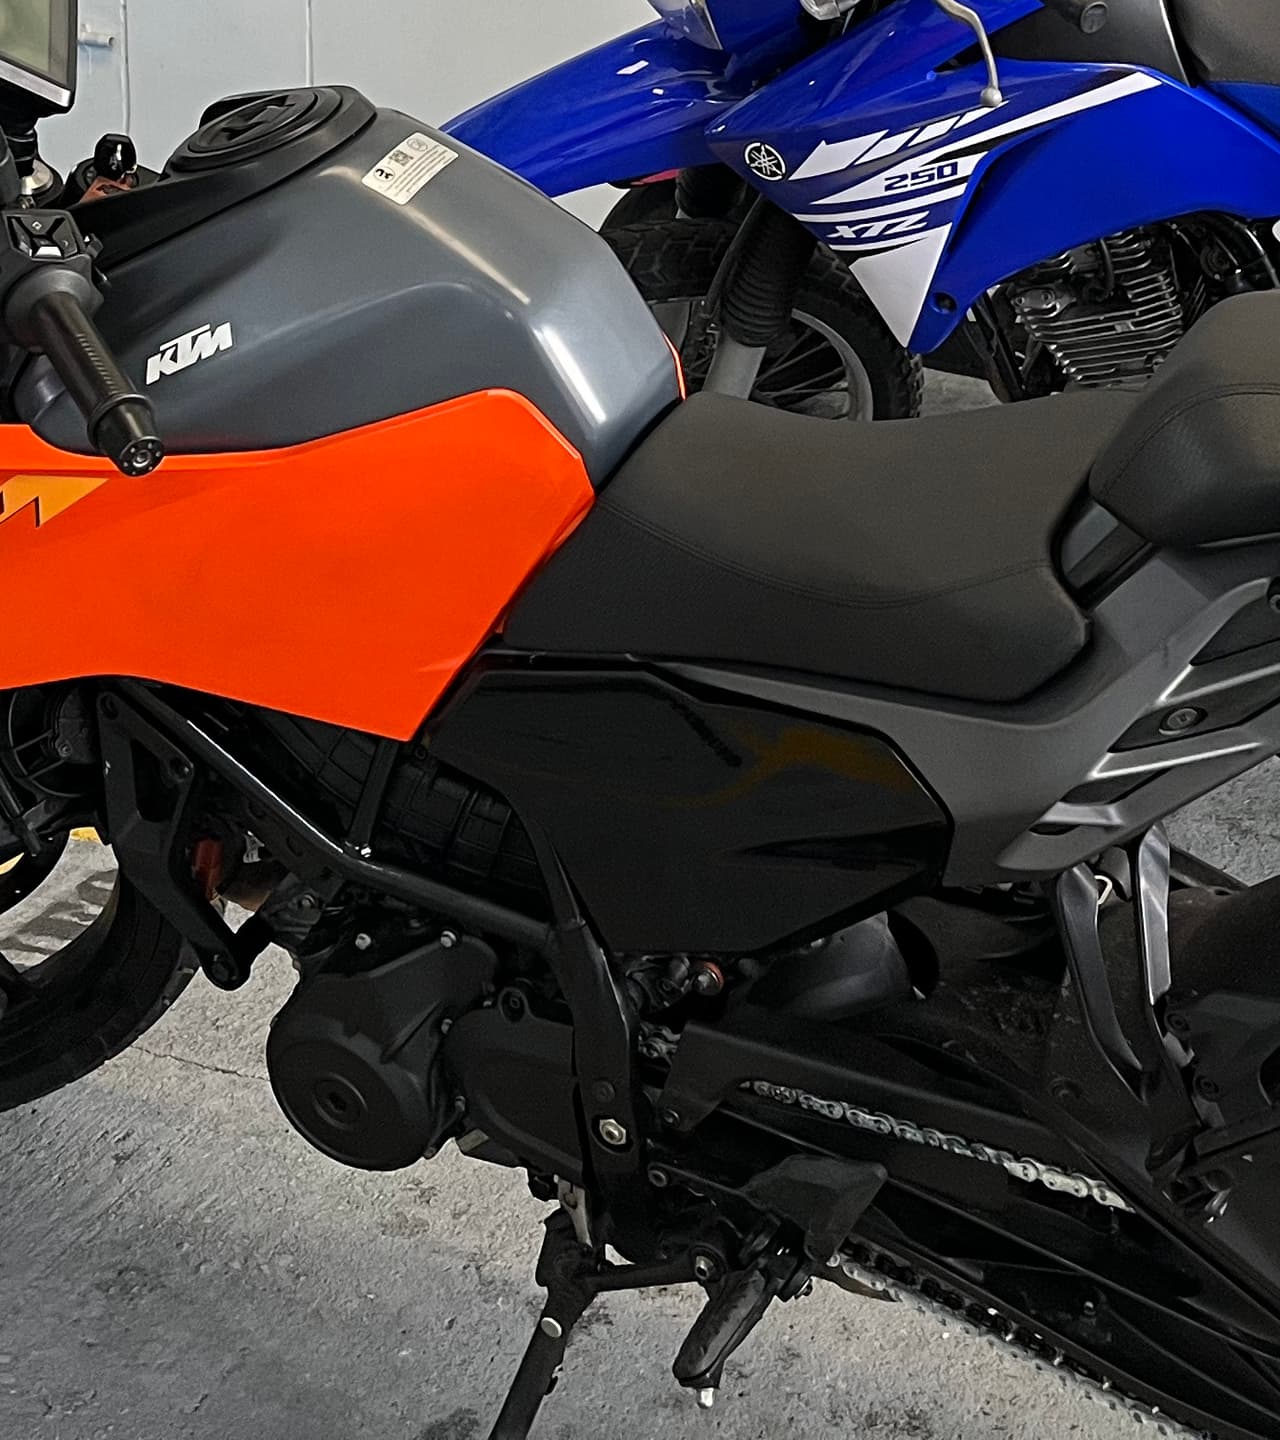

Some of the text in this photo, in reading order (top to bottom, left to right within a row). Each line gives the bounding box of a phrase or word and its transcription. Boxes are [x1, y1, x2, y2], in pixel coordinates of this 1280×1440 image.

[884, 163, 958, 191] 250
[828, 212, 927, 240] XTZ
[146, 324, 233, 385] KTM
